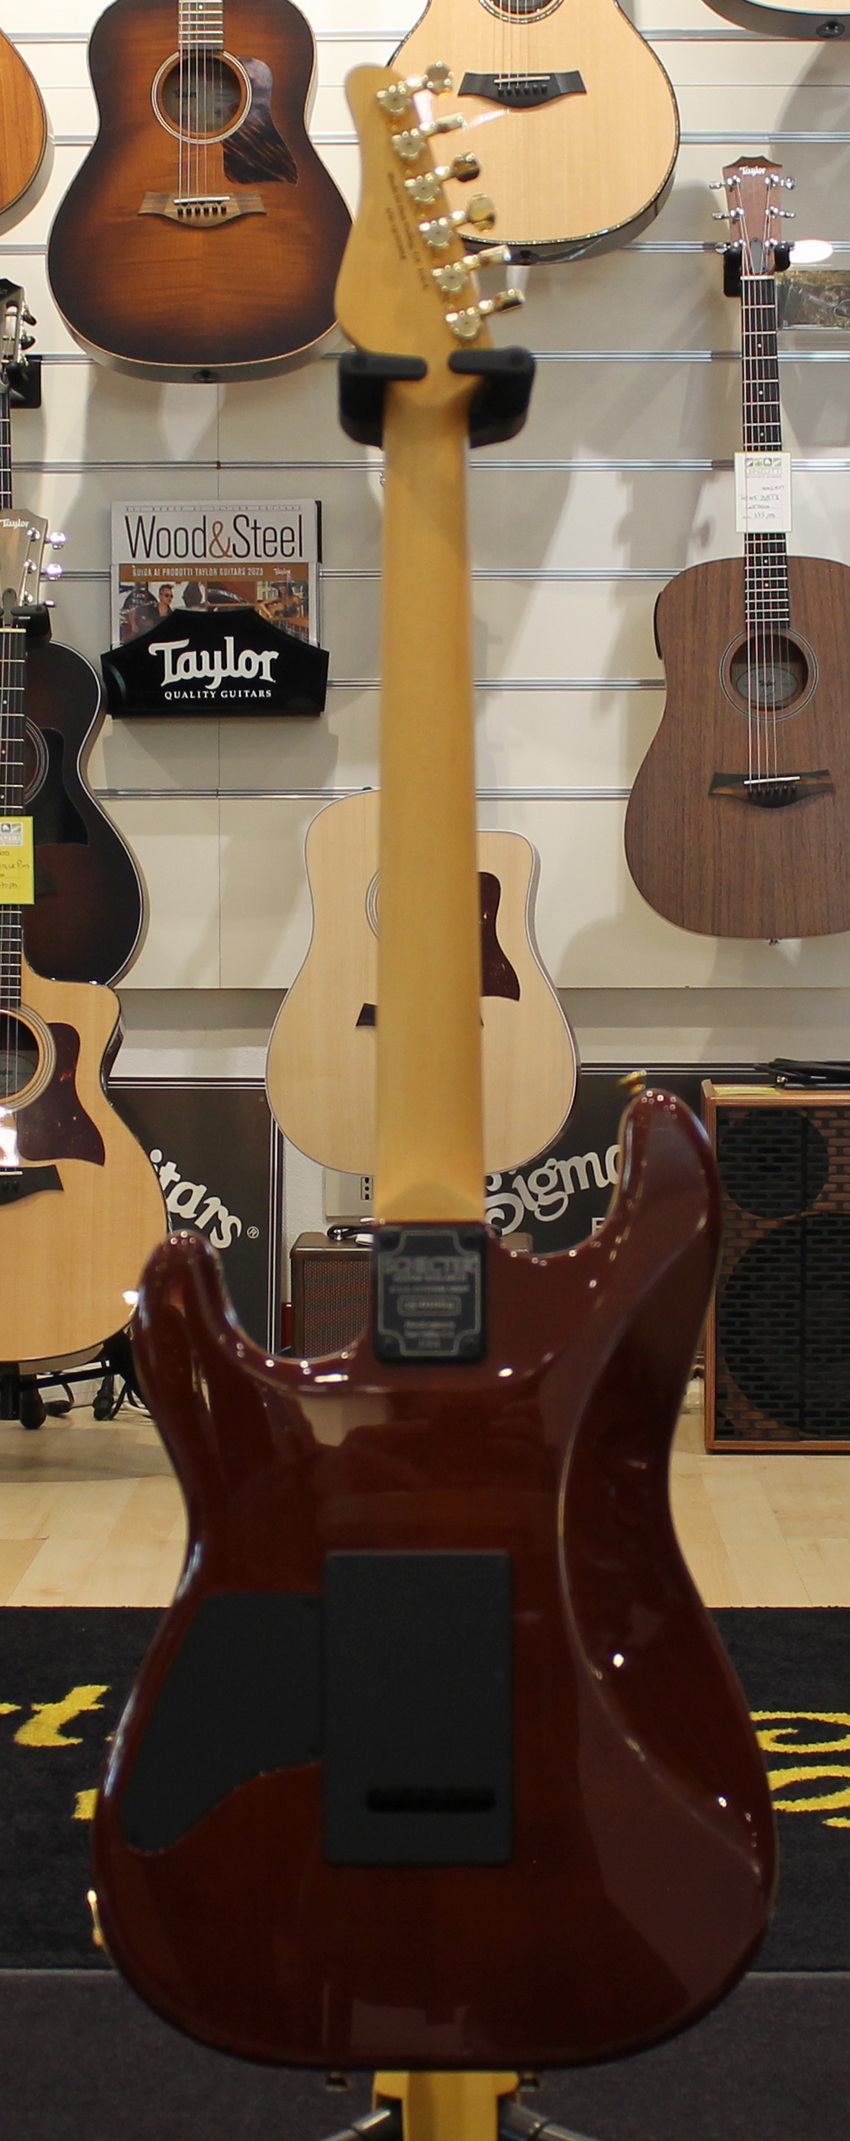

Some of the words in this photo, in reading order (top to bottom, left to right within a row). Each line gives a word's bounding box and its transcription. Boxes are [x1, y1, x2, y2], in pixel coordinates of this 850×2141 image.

[739, 166, 766, 177] Taylor
[0, 518, 30, 530] Taylor
[125, 514, 303, 559] Wood&Steel
[132, 568, 152, 577] GUIDA
[154, 568, 160, 576] AI
[162, 567, 193, 576] PRODOTTI
[195, 567, 218, 576] TAYLOR
[220, 567, 246, 576] GUITARS
[247, 567, 264, 576] 2023
[148, 636, 279, 690] Taylor
[164, 690, 215, 700] QUALITY
[220, 689, 272, 699] GUITARS
